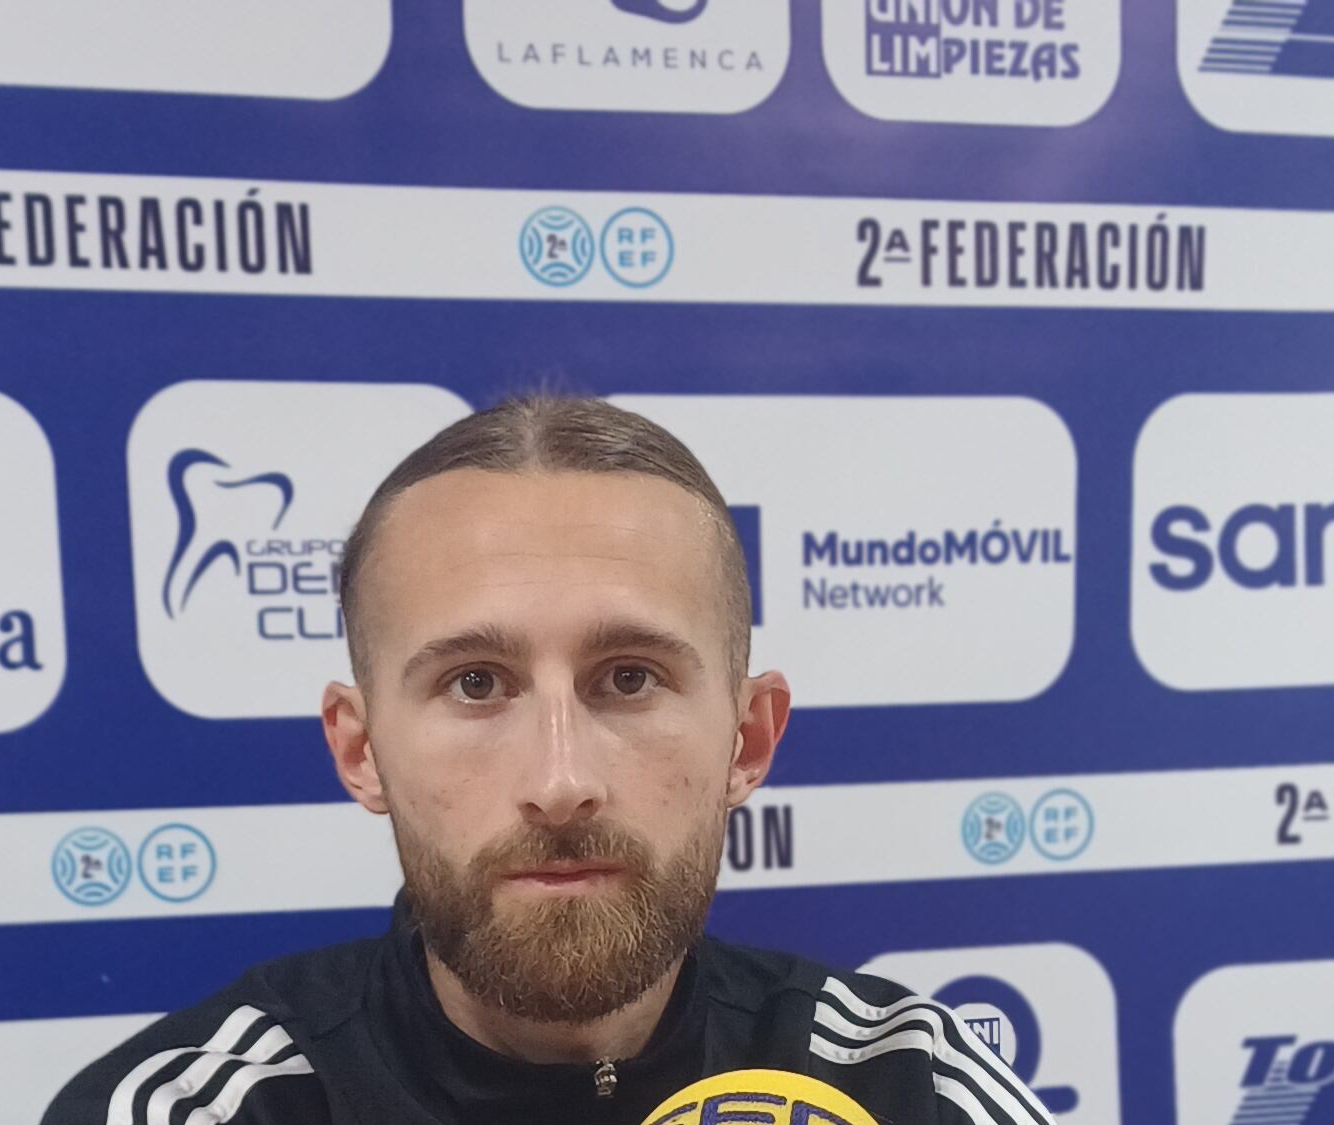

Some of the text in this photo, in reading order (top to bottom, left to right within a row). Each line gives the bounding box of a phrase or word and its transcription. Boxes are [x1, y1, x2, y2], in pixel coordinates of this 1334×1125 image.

[1014, 0, 1065, 30] DE
[497, 41, 764, 72] LAFLAMENCA
[869, 34, 1080, 81] LIMPIEZAS
[920, 212, 1207, 292] FEDERACIÓN
[802, 518, 1072, 567] MundoMÓVIL
[803, 575, 945, 609] Network
